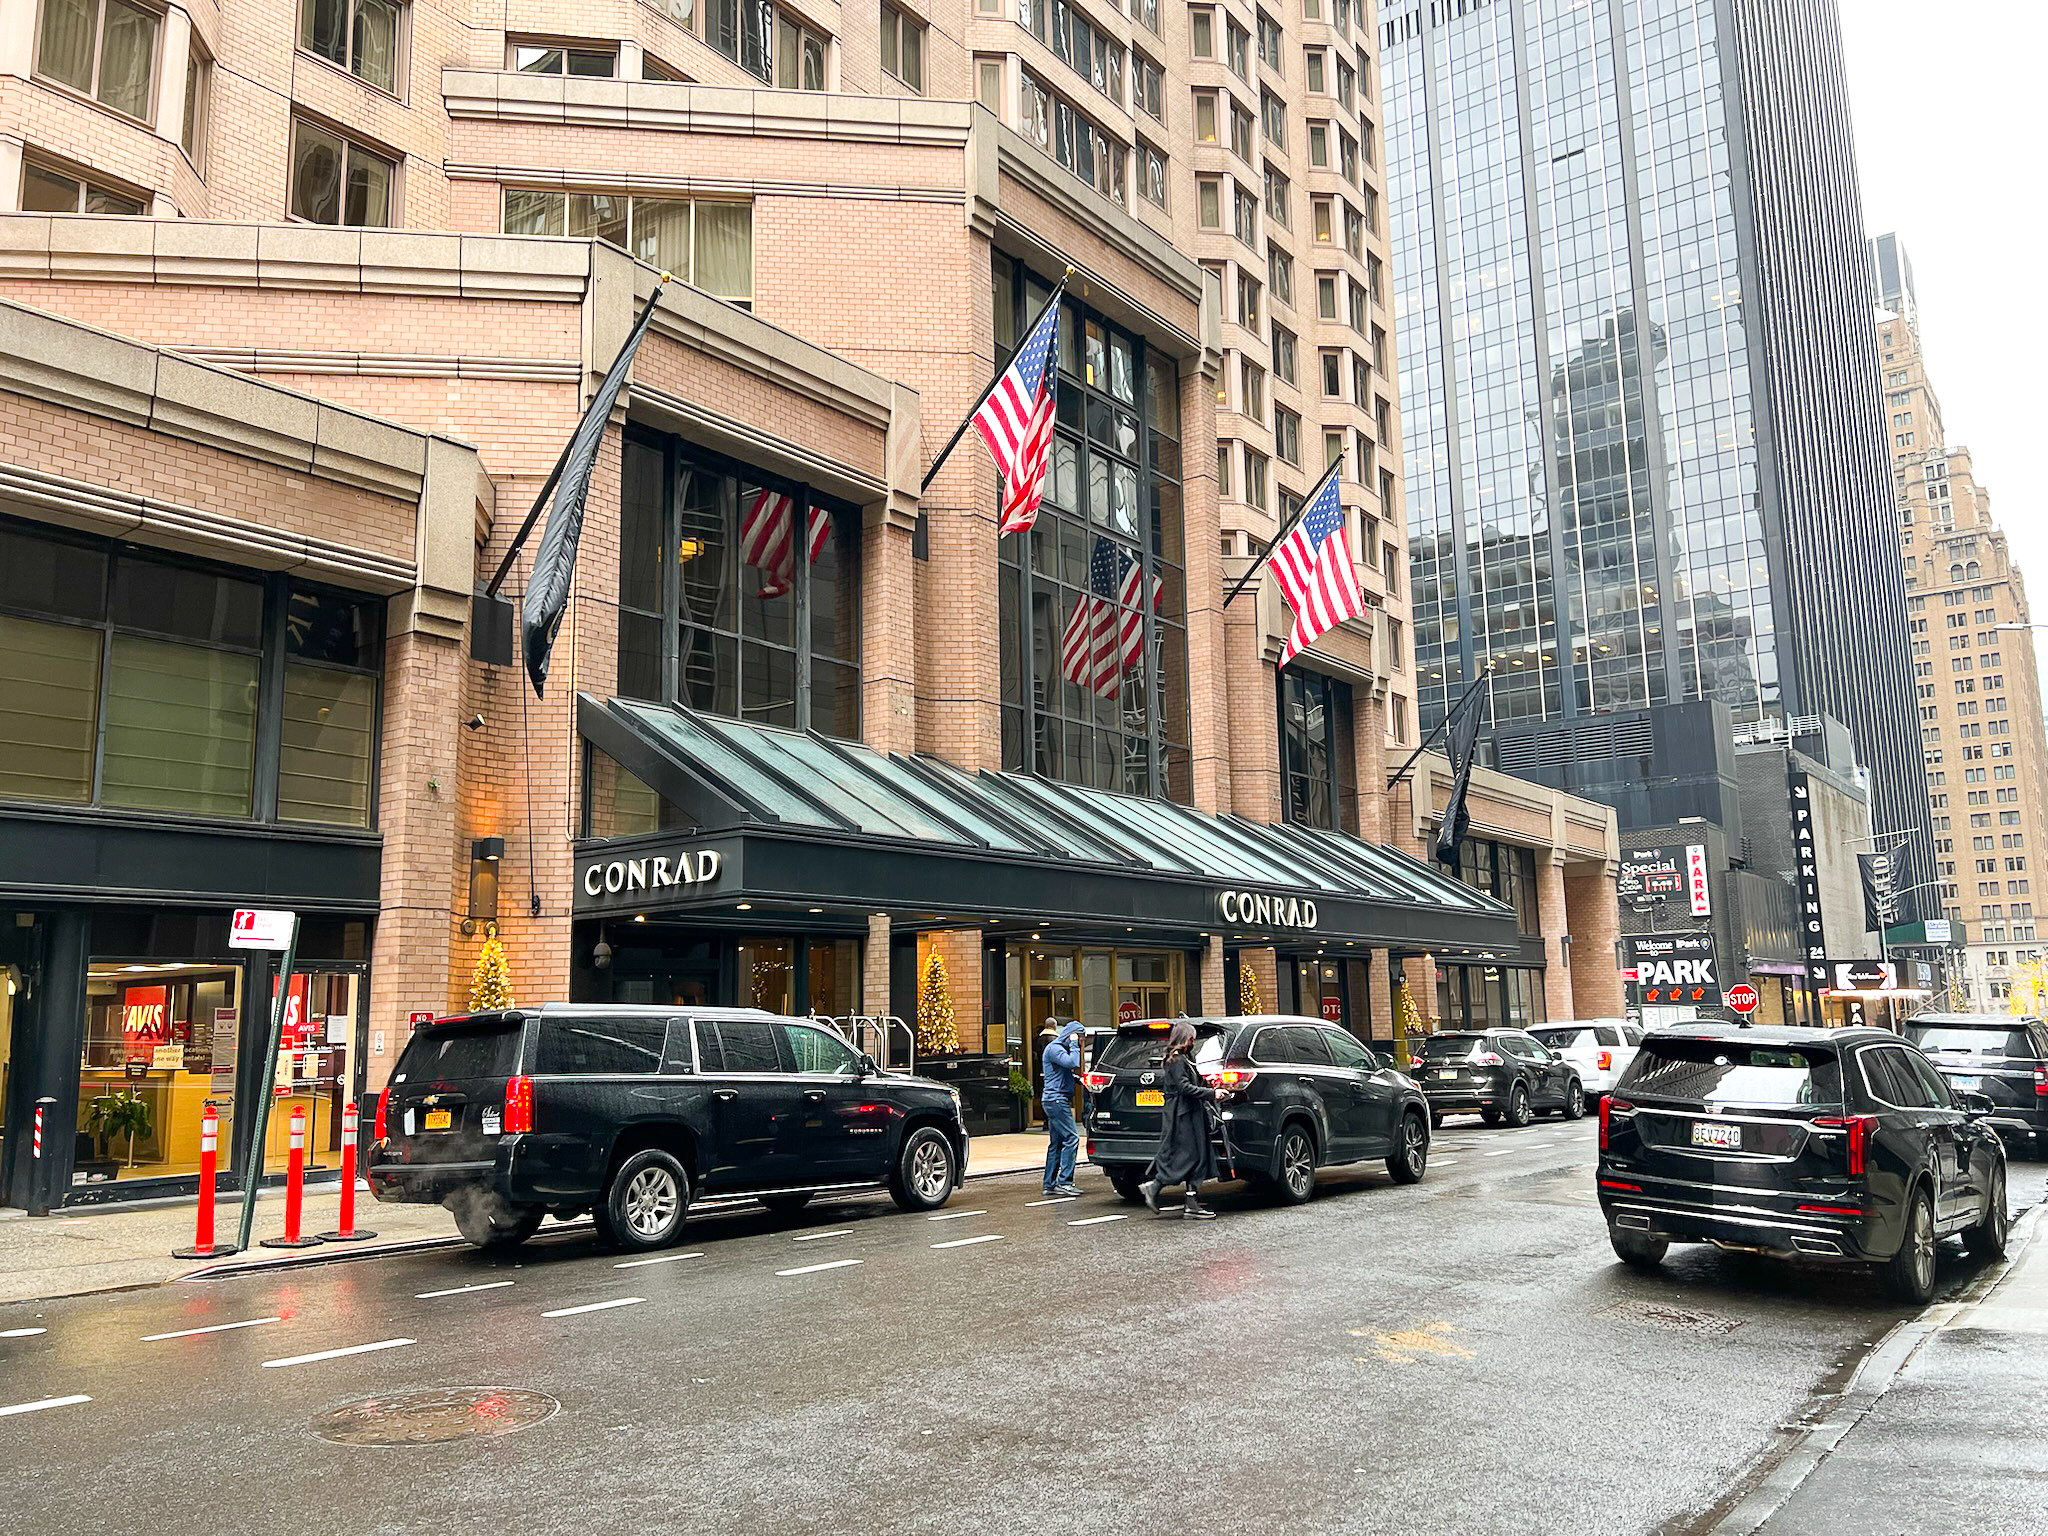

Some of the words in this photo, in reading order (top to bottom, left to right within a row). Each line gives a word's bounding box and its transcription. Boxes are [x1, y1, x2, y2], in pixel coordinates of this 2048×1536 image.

[584, 850, 722, 896] CONRAD
[1621, 857, 1676, 877] Special
[1692, 855, 1705, 901] PARK
[1797, 809, 1821, 933] PARKING
[1220, 890, 1318, 929] CONRAD
[1635, 939, 1673, 951] Welcome
[1637, 958, 1716, 986] PARK
[1730, 992, 1755, 1005] STOP
[125, 1004, 164, 1033] AVIS
[298, 1024, 316, 1032] AVIS
